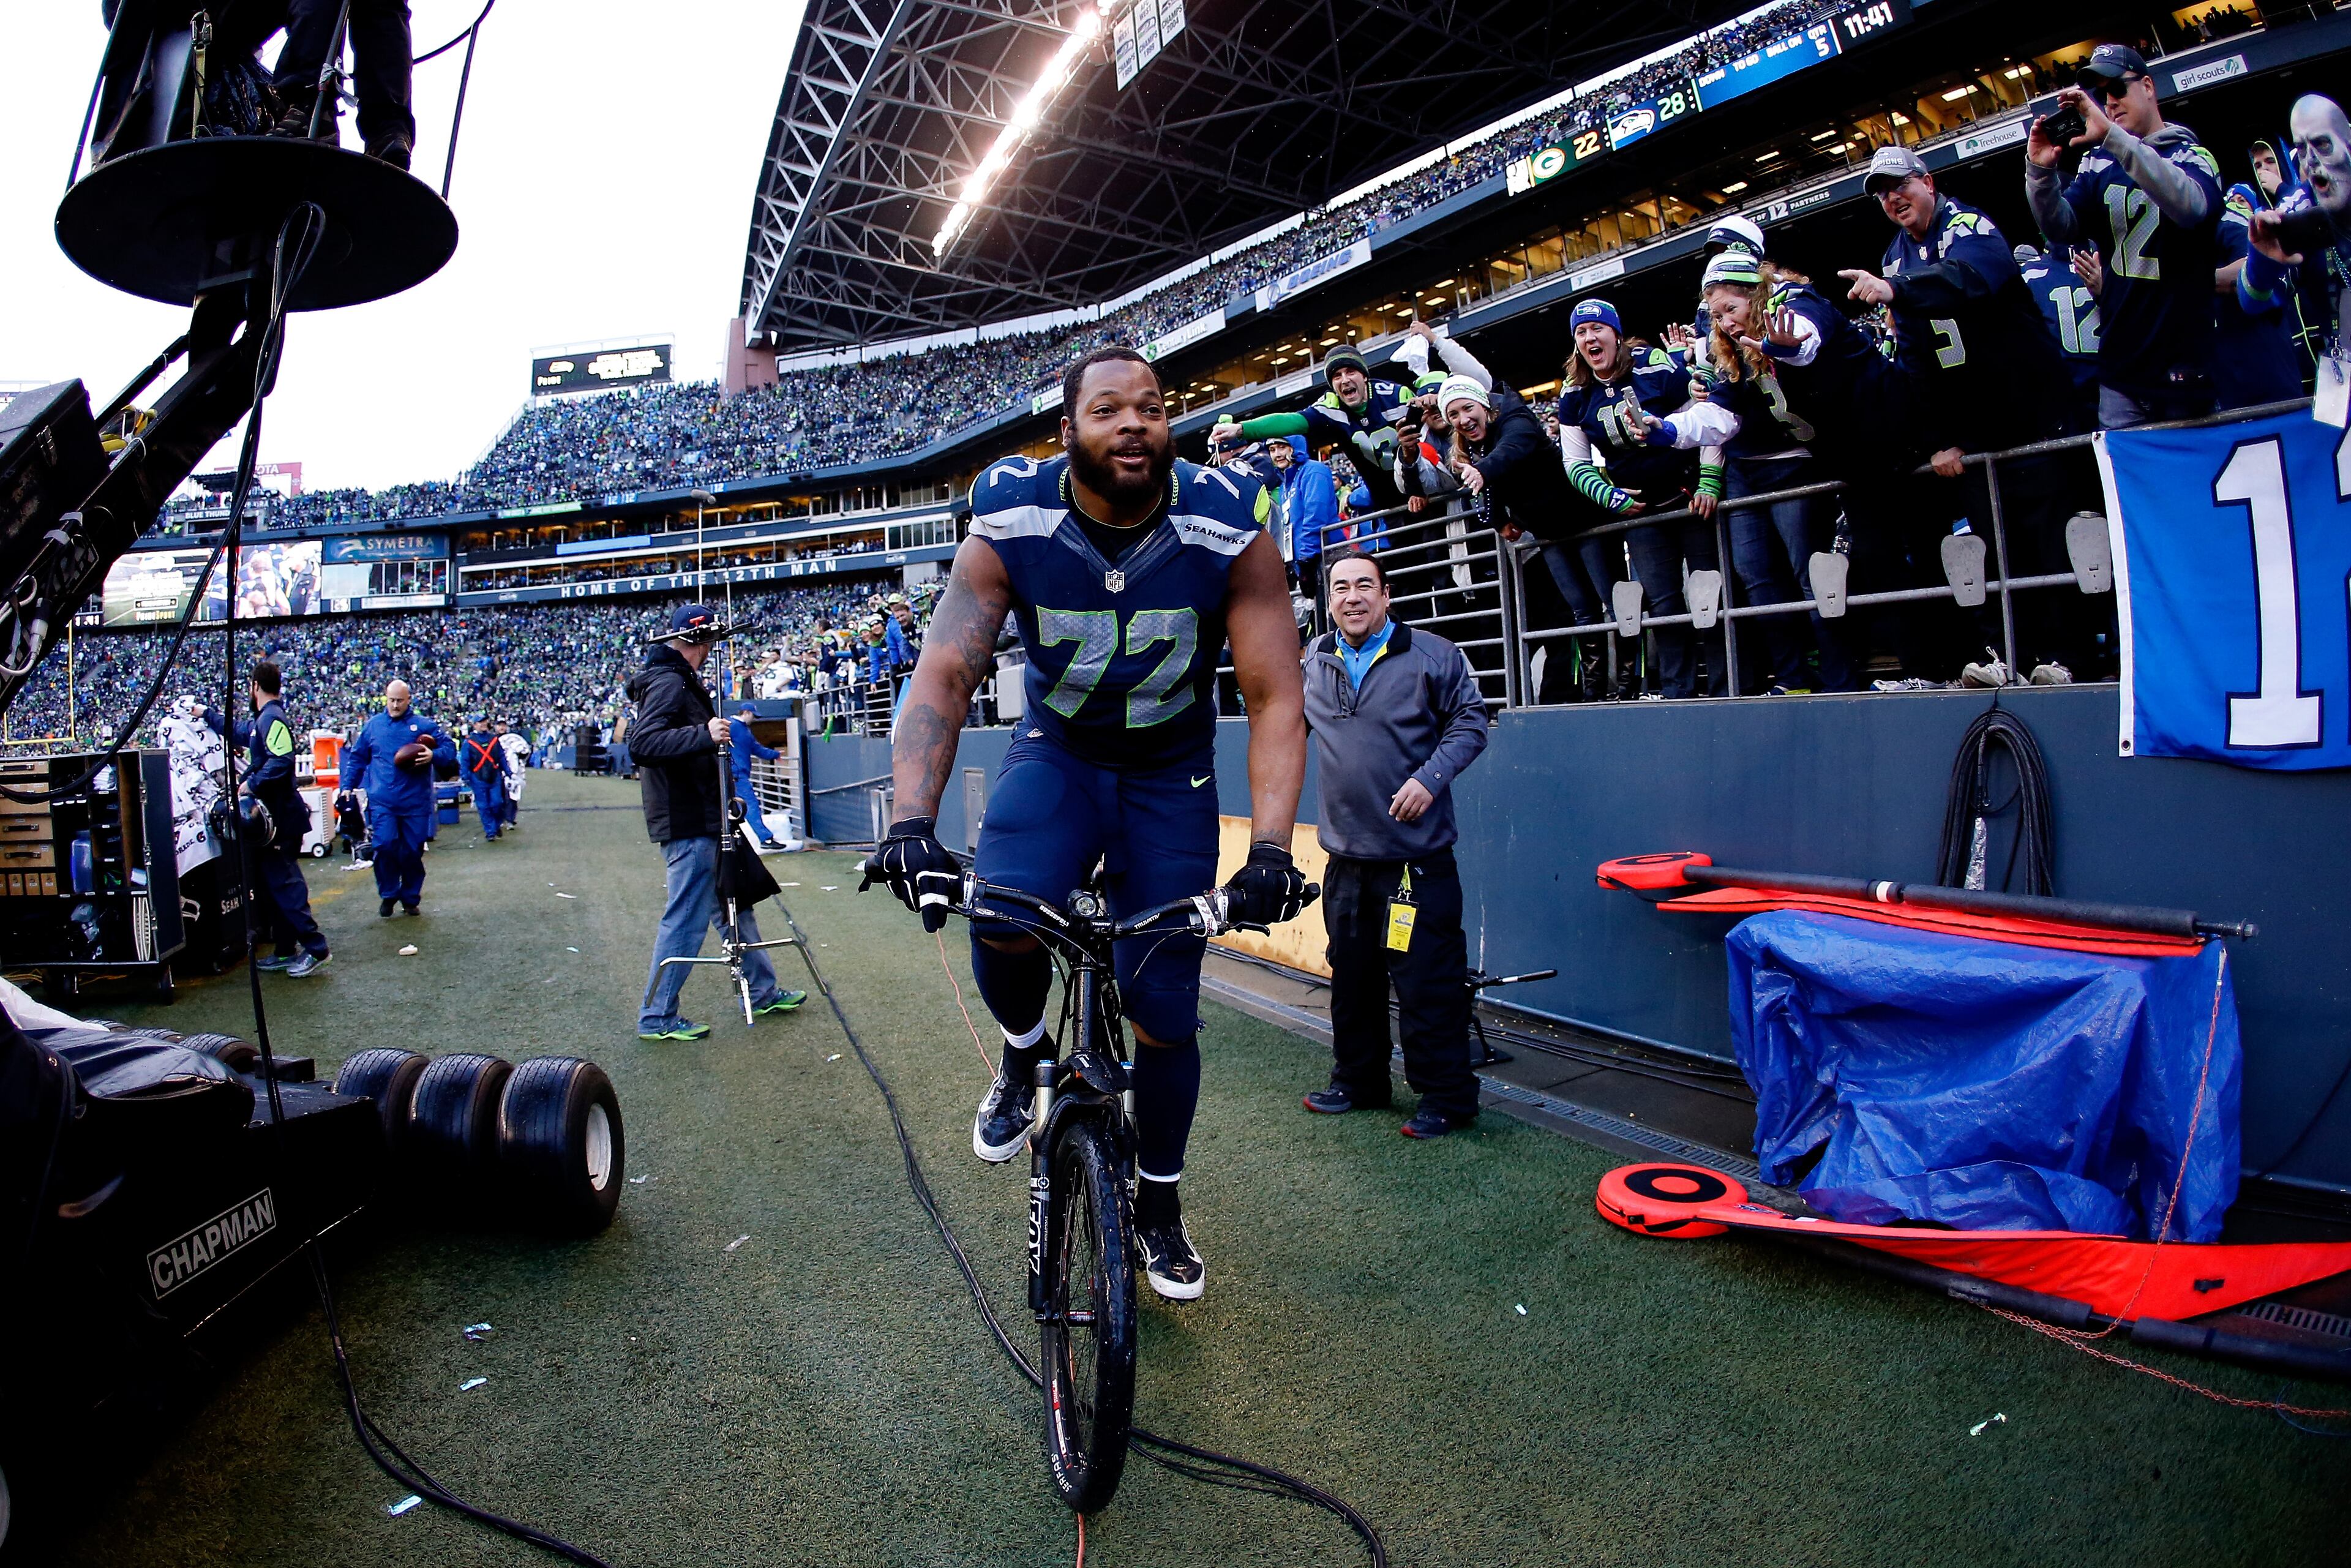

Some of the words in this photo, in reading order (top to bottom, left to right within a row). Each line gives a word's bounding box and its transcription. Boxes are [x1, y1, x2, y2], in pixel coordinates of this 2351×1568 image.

[1162, 4, 1182, 29] CHAMPS
[1843, 1, 1893, 39] 11:41
[1807, 24, 1827, 40] QTR
[1698, 68, 1726, 88] DOWN
[1732, 61, 1745, 72] TO
[1745, 54, 1760, 67] GO
[1766, 41, 1789, 58] BALL
[1788, 35, 1803, 49] ON
[1815, 37, 1829, 57] 5
[2181, 73, 2195, 89] girl
[2197, 67, 2225, 81] scouts
[1657, 92, 1685, 121] 28
[1573, 131, 1600, 160] 22
[1978, 130, 2017, 148] Treehouse
[1768, 202, 1789, 222] 12
[1790, 191, 1831, 211] PARTNERS
[2104, 184, 2160, 280] 12
[1287, 249, 1352, 290] BOEING
[2049, 286, 2102, 353] 12
[1374, 382, 1395, 396] 12
[367, 536, 434, 550] SYMETRA
[1184, 523, 1246, 545] SEAHAWKS
[561, 582, 617, 599] HOME
[631, 579, 655, 591] OF
[669, 572, 707, 588] THE
[722, 567, 775, 583] 12TH
[790, 560, 837, 576] MAN
[1109, 580, 1122, 588] NFL
[1036, 605, 1199, 729] 72
[1134, 912, 1160, 929] TRUVATIV
[154, 1195, 273, 1289] CHAPMAN
[1051, 1453, 1073, 1493] SERFAS
